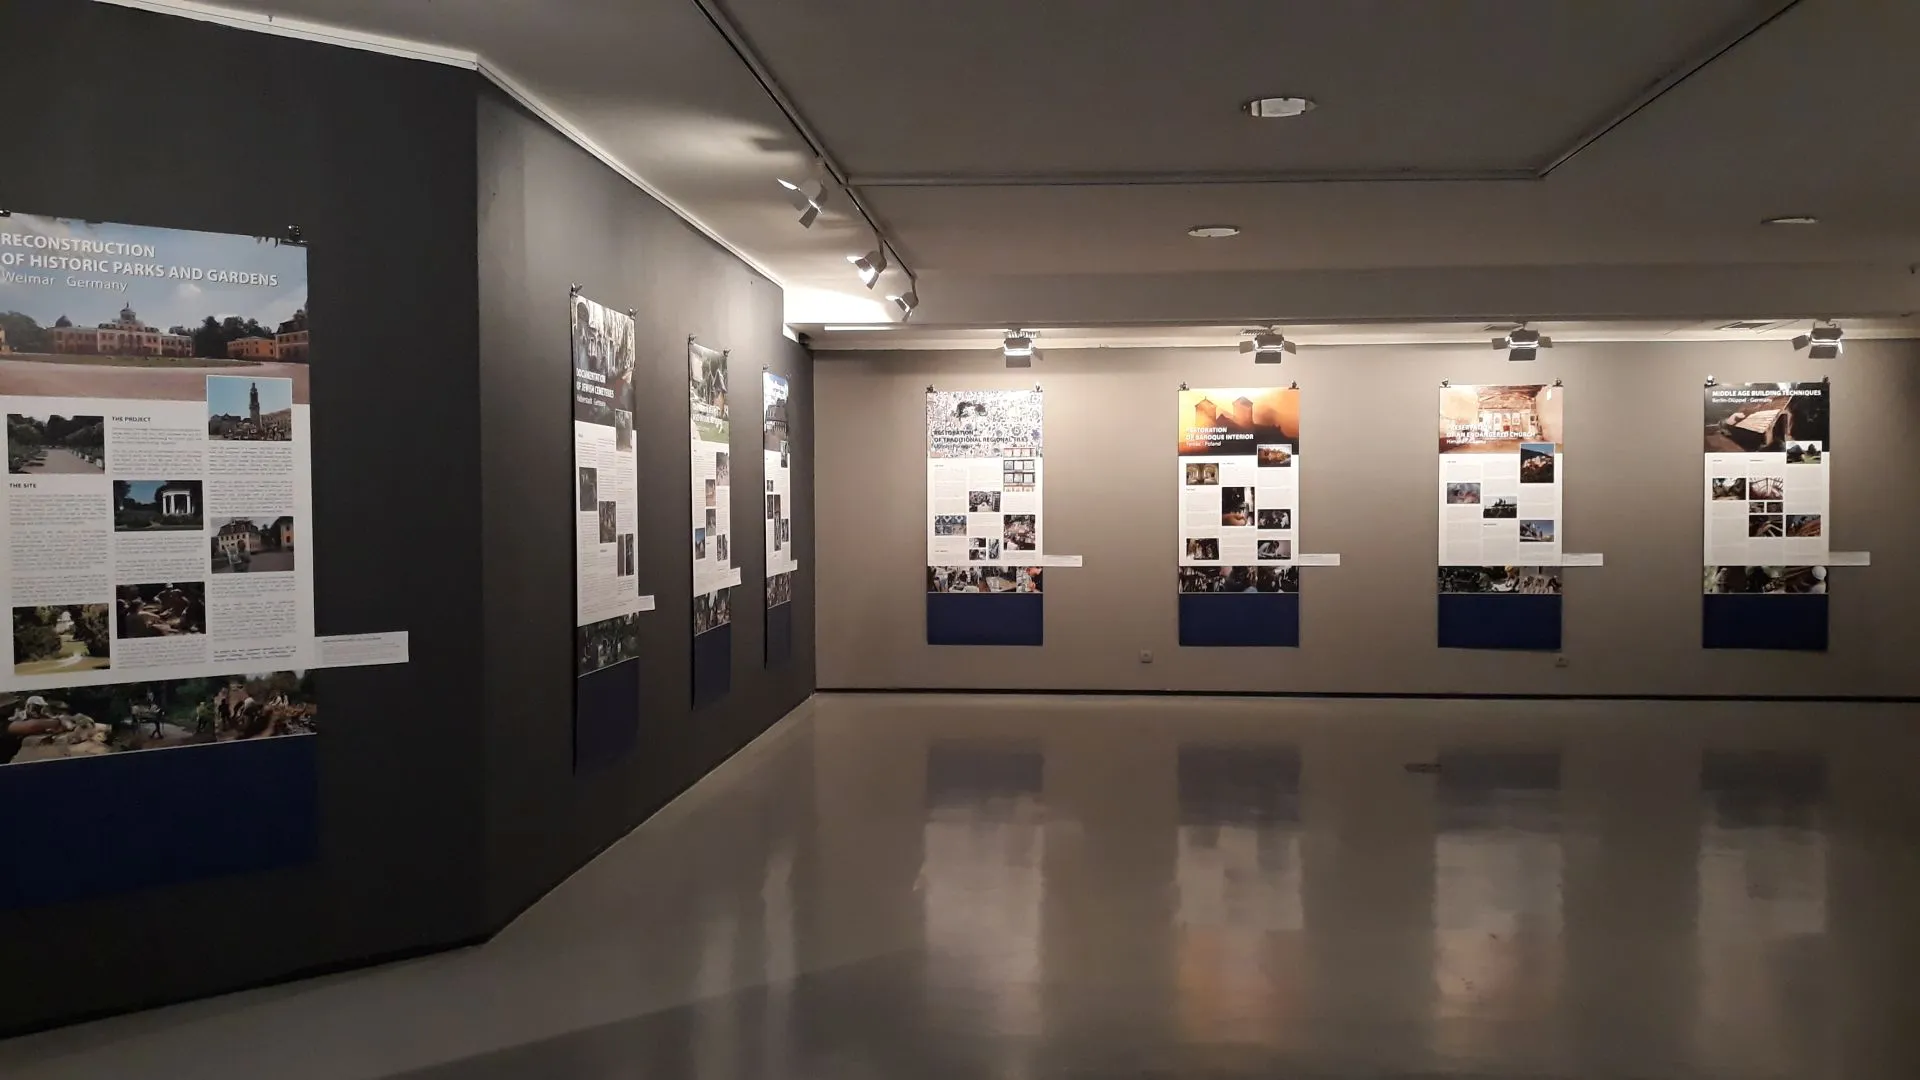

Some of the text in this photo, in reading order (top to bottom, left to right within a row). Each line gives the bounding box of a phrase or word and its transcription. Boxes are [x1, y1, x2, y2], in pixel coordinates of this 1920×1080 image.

[1, 232, 156, 258] RECONSTRUCTION
[2, 252, 279, 287] OF HISTORIC PARKS AND GARDENS
[2, 270, 128, 293] Weimar Germany
